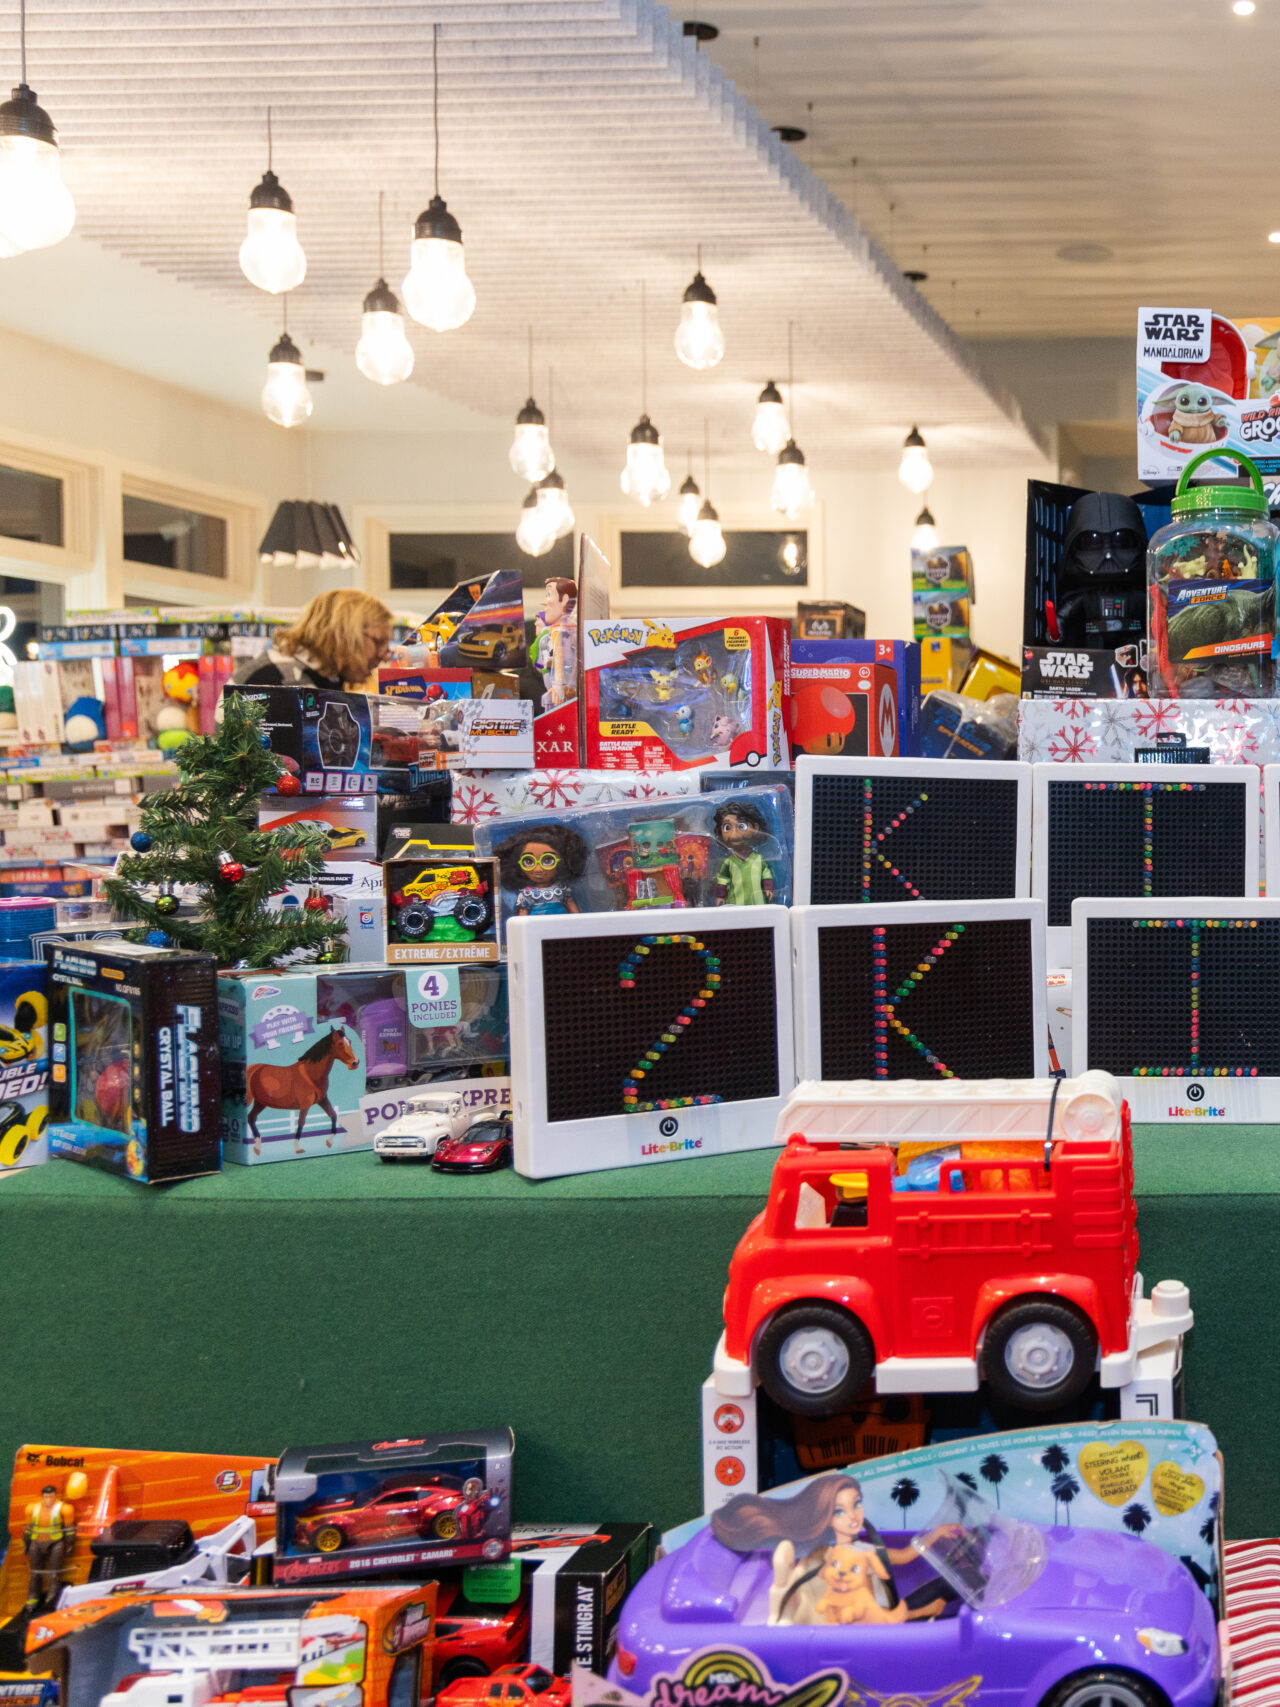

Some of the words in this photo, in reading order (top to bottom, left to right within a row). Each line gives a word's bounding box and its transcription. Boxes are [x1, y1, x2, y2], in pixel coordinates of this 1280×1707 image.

[1144, 313, 1205, 328] STAR
[1144, 327, 1205, 341] WARS
[1143, 346, 1204, 359] MANDALORIAN
[1241, 411, 1267, 422] WILD
[1176, 585, 1228, 601] ADVENTURE
[1193, 593, 1224, 603] FORCE
[878, 644, 891, 655] 3+
[1214, 641, 1265, 653] DINOSAURS
[1039, 652, 1093, 666] STAR
[820, 668, 850, 678] MARIO
[1039, 665, 1093, 679] WARS
[862, 778, 930, 901] K
[424, 976, 440, 996] 4
[873, 924, 966, 1080] K
[1132, 919, 1259, 1077] I
[411, 1000, 458, 1013] PONIES
[413, 1011, 457, 1022] INCLUDED
[618, 933, 722, 1113] 2
[159, 1027, 172, 1089] CRYSTAL
[160, 1090, 174, 1127] BALL
[45, 1455, 84, 1468] Bobcat
[1084, 1456, 1119, 1470] STEERING
[222, 1473, 235, 1485] 5
[373, 1555, 414, 1566] CHEVROLET
[421, 1550, 453, 1560] CAMARO
[576, 1585, 594, 1653] STINGRAY
[35, 1627, 54, 1640] 3+
